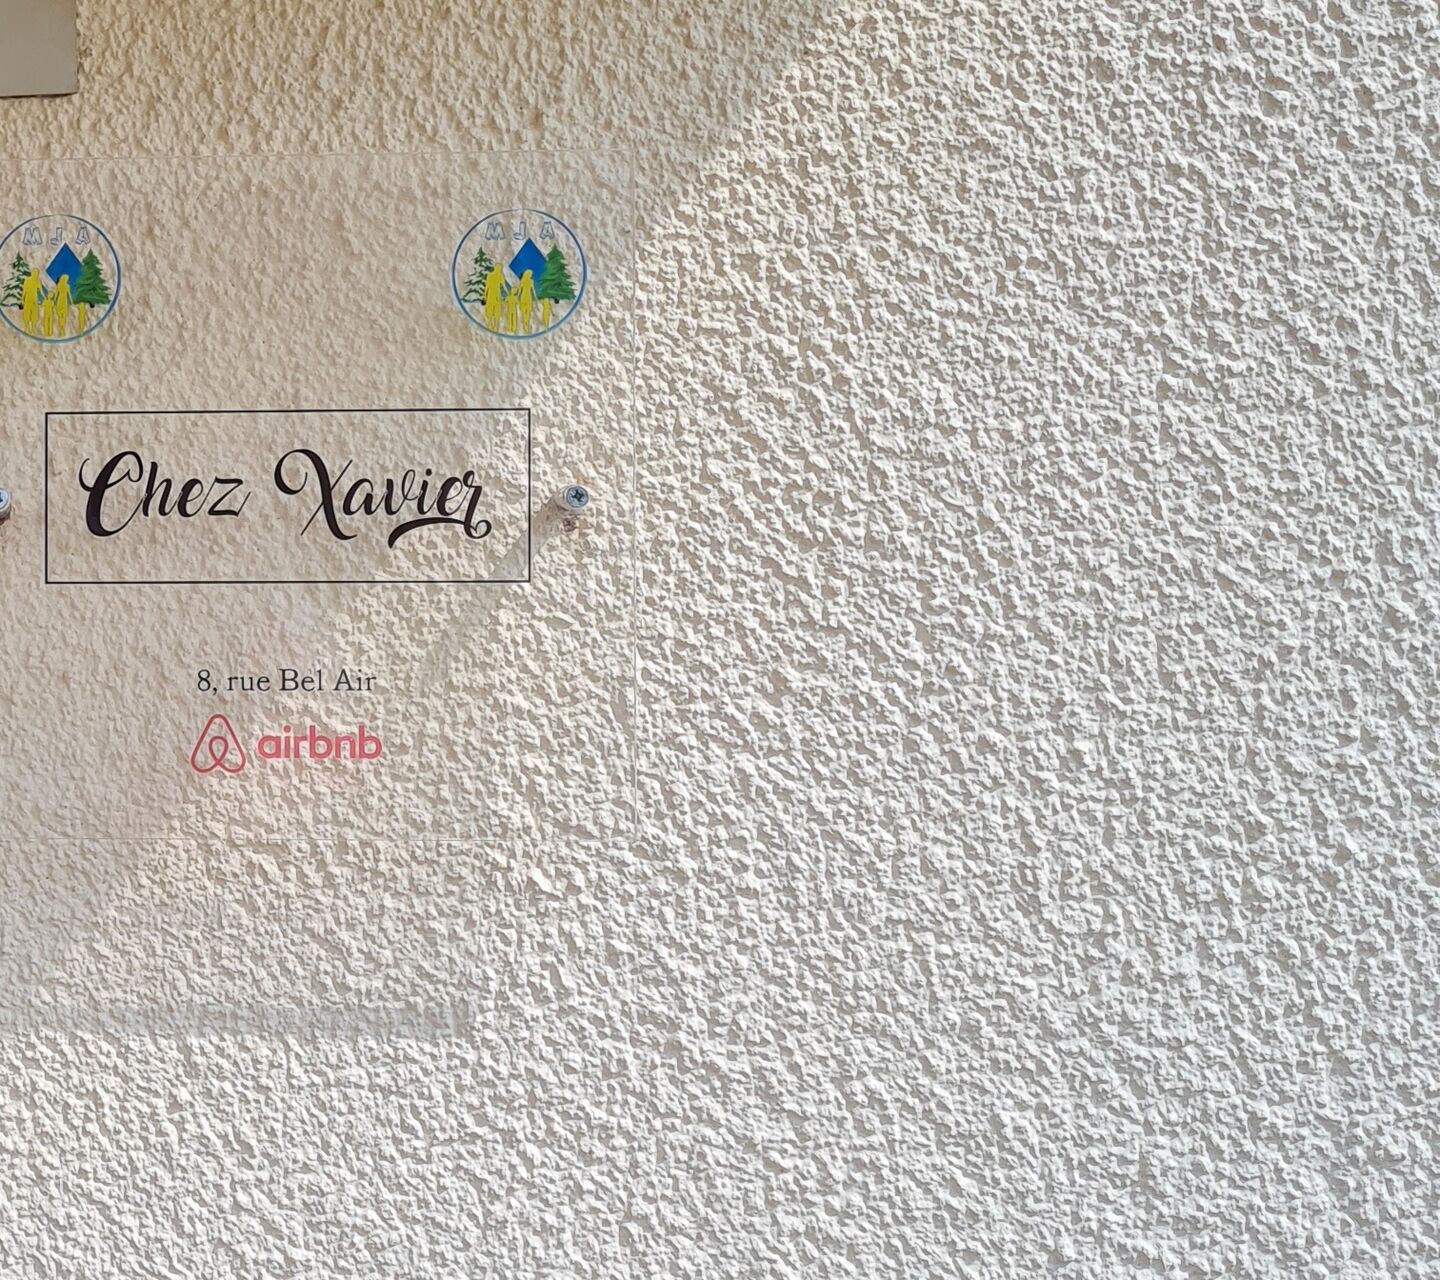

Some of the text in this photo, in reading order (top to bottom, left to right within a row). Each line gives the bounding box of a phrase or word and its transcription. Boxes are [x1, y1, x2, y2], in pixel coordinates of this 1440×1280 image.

[78, 448, 492, 549] Chez Xavier
[197, 668, 377, 695] 8, rue Bel Air
[257, 724, 383, 760] airbnb
